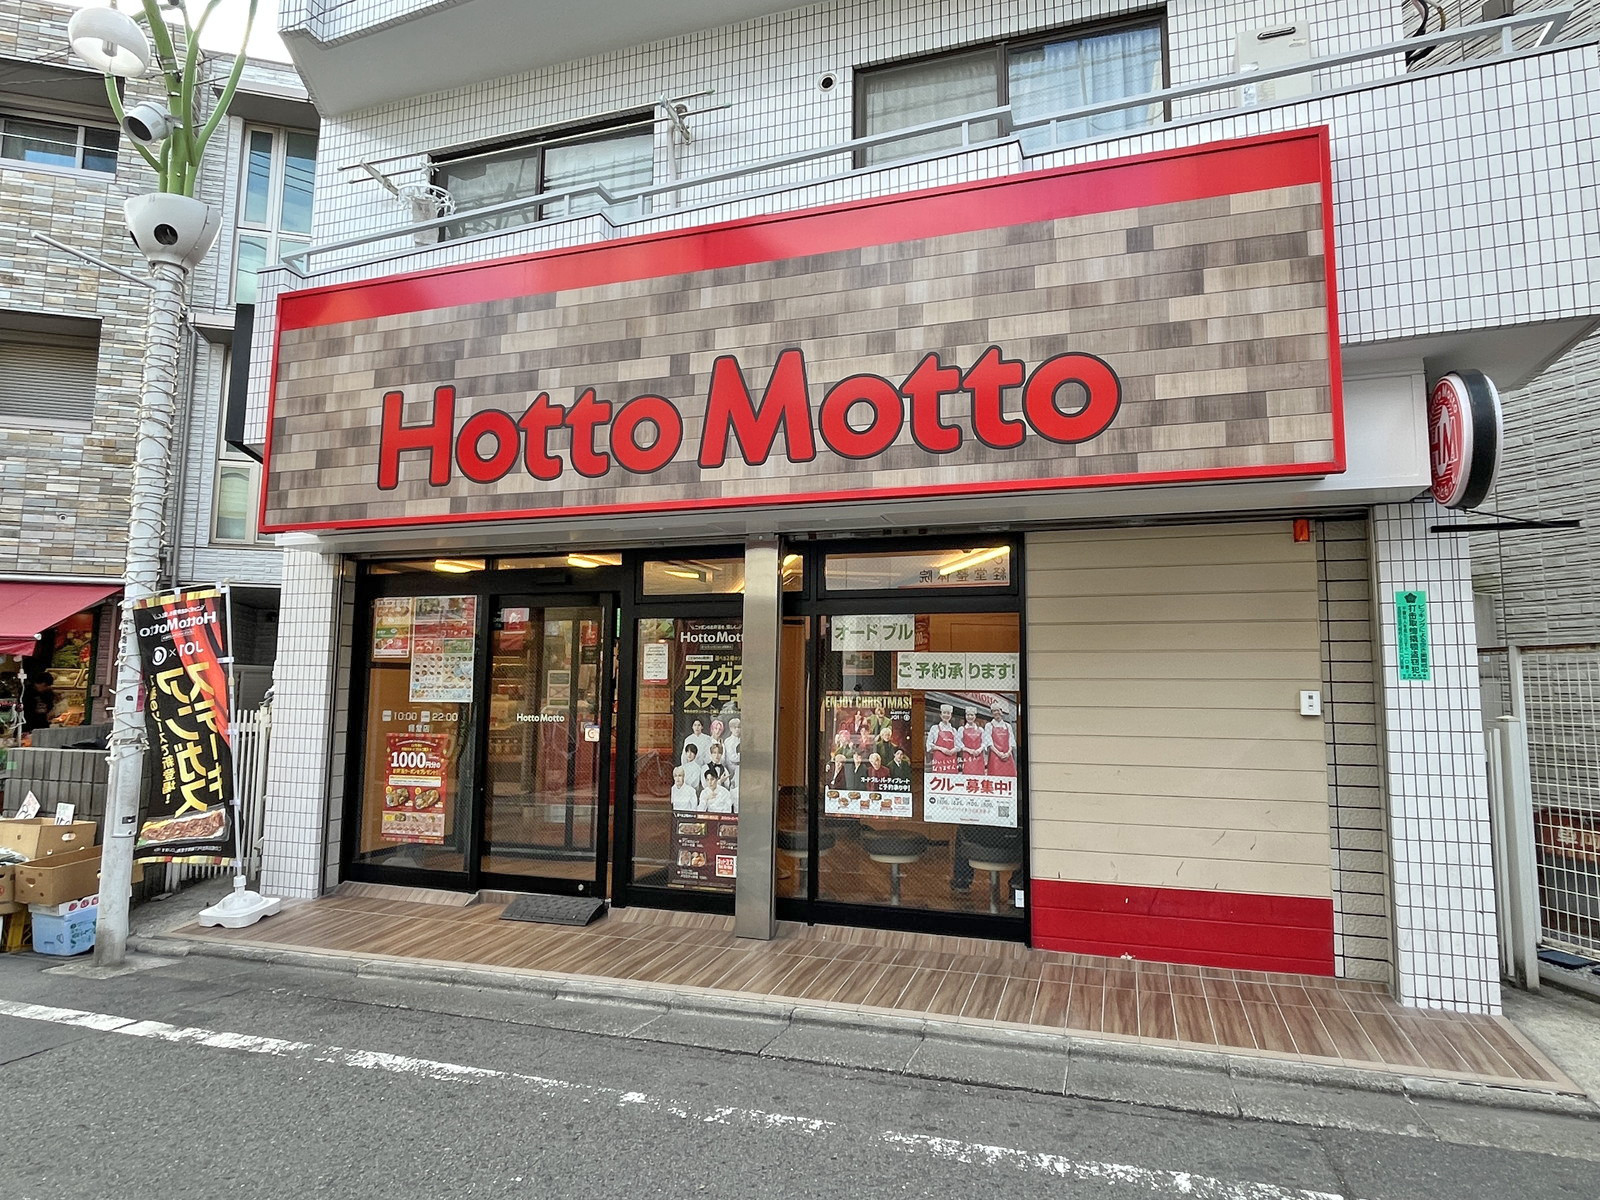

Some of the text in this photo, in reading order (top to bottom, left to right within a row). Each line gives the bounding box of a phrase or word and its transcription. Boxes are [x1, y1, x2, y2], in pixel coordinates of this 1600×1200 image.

[377, 345, 1122, 491] Hotto Motto
[835, 623, 914, 641] オードブル
[898, 662, 1016, 680] ご予約承ります!
[825, 696, 912, 709] ENJOY CHRISTMAS!
[394, 711, 418, 721] 10:00
[432, 712, 459, 722] 22:00
[929, 777, 1012, 796] クルー募集中!
